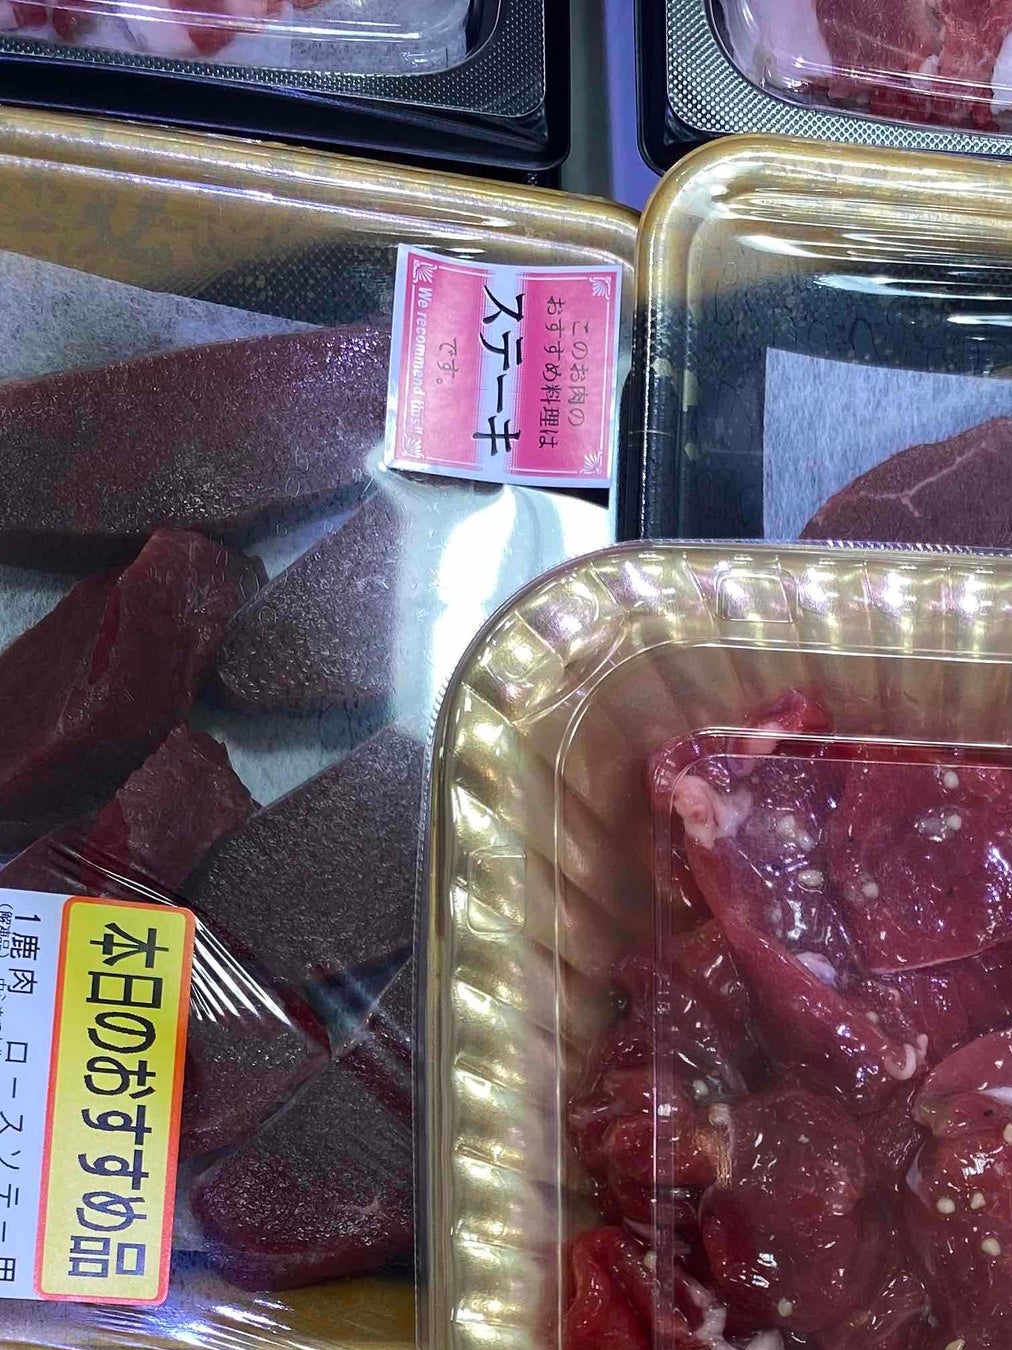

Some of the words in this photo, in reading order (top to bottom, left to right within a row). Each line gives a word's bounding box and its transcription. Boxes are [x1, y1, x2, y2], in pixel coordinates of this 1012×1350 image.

[418, 287, 433, 309] We
[412, 311, 428, 396] recommend
[436, 338, 459, 385] です。
[472, 285, 526, 456] ステーキ
[539, 296, 566, 449] おすすめ料理は
[568, 321, 589, 427] このお肉の
[68, 923, 169, 1278] 本日のおすすめ品
